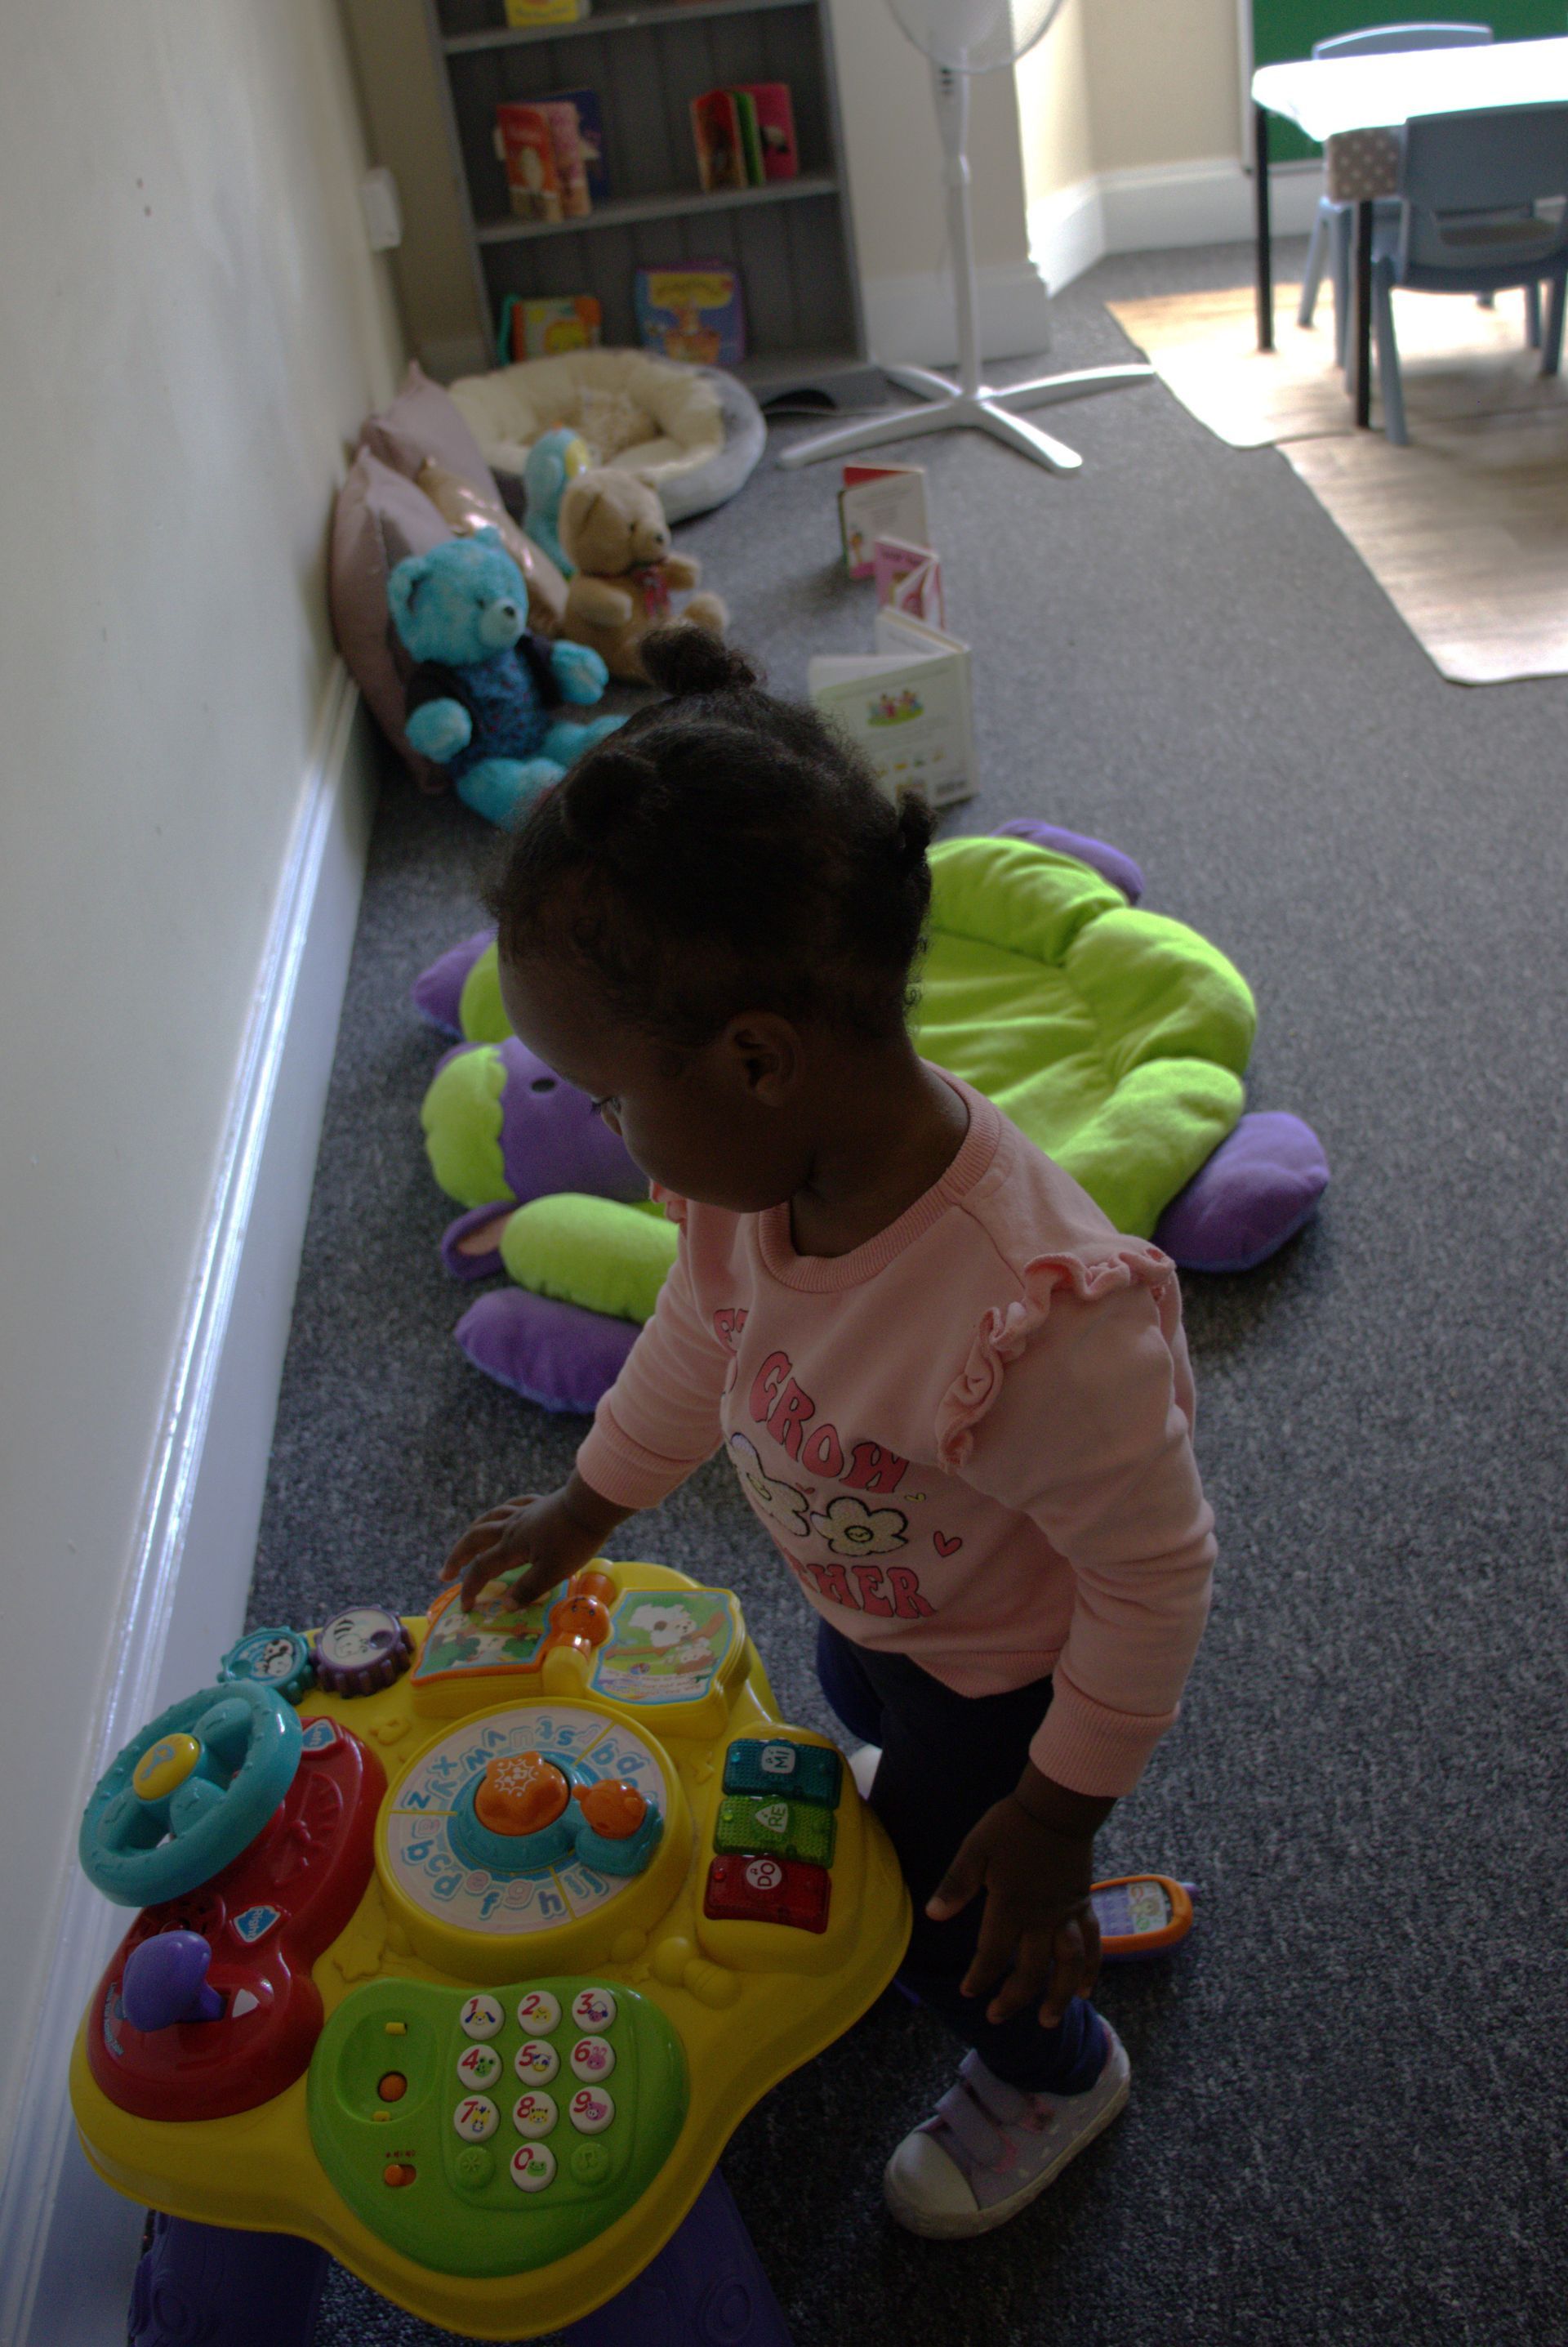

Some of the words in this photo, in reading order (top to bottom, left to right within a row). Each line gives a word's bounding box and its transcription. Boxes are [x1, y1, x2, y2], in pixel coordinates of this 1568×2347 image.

[749, 1350, 910, 1494] GROW
[555, 1729, 576, 1747] s
[768, 1806, 786, 1828] RE
[757, 1862, 776, 1887] DO
[469, 1998, 479, 2015] 1
[521, 1994, 541, 2016] 2
[577, 1992, 595, 2015] 3
[461, 2048, 480, 2071] 4
[519, 2044, 537, 2067] 5
[574, 2040, 592, 2062] 6
[460, 2100, 479, 2123] 7
[516, 2095, 536, 2118] 8
[573, 2090, 592, 2113] 9
[514, 2147, 534, 2171] 0
